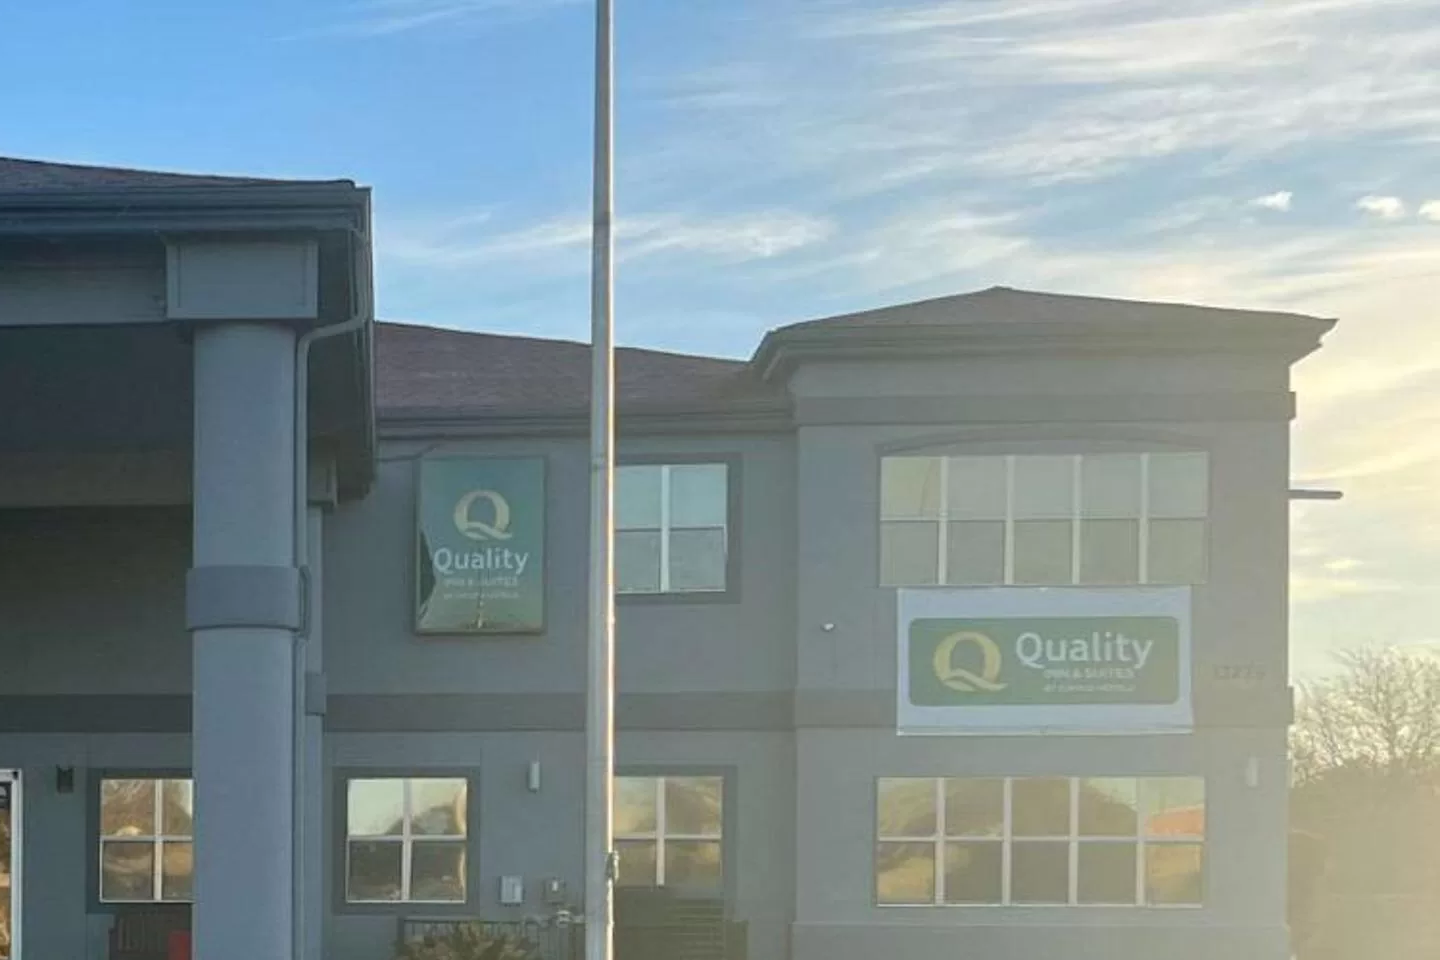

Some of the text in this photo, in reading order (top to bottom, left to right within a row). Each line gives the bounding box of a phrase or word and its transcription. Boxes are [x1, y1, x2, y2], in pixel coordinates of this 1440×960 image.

[453, 489, 513, 540] Q
[433, 548, 529, 575] Quality
[932, 631, 1008, 692] Q
[1015, 631, 1155, 669] Quality
